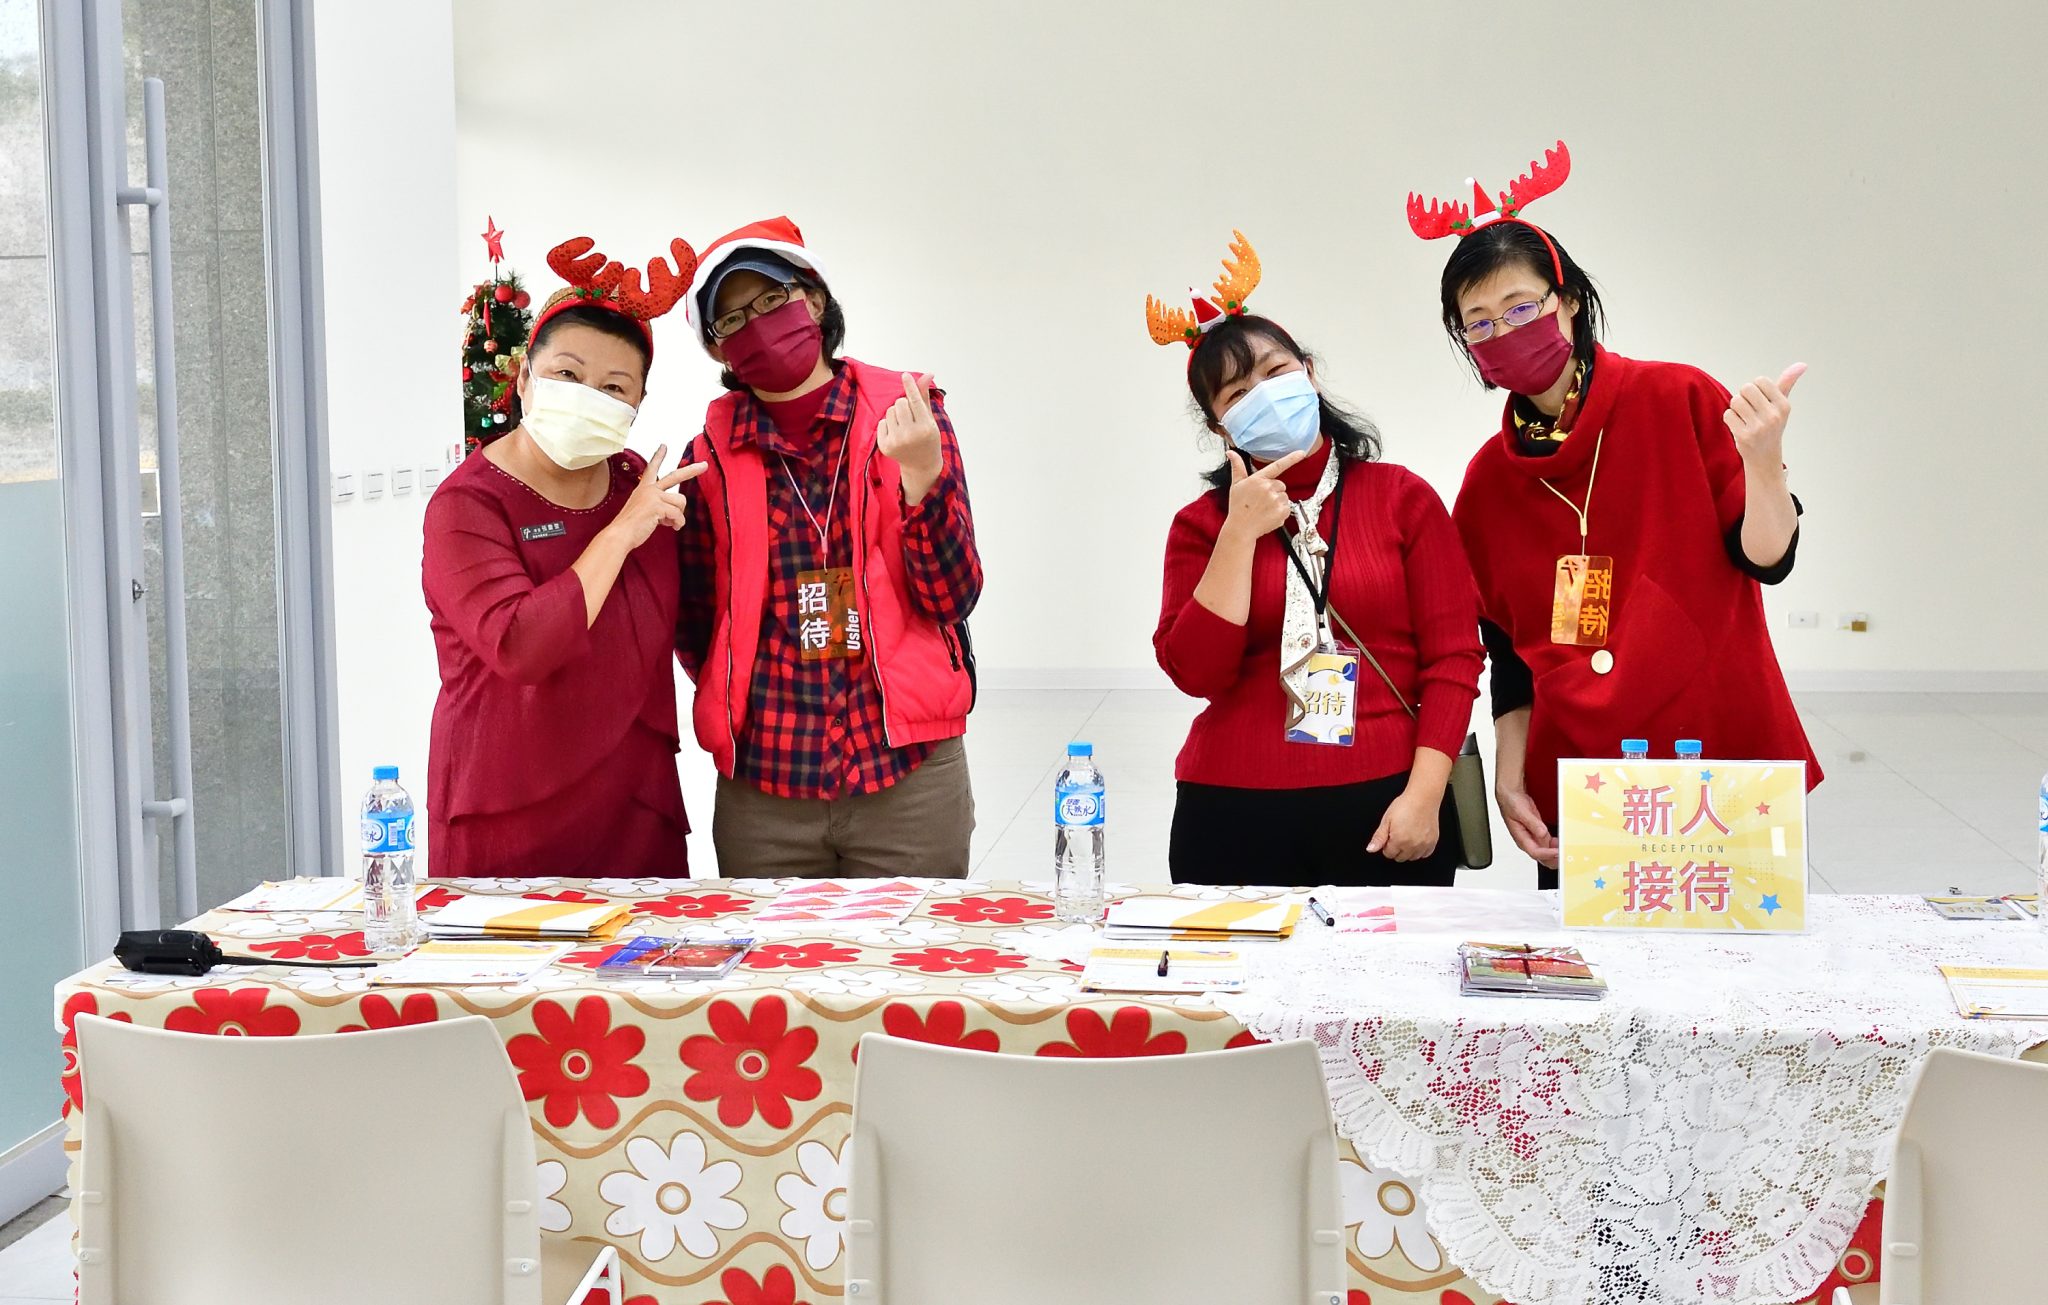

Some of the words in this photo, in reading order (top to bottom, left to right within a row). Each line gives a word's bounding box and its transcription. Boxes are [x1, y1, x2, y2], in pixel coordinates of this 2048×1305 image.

[798, 582, 831, 650] 招待
[845, 608, 861, 650] Usher
[1622, 784, 1734, 837] 新人
[1641, 844, 1724, 853] RECEPTION
[1622, 860, 1734, 913] 接待
